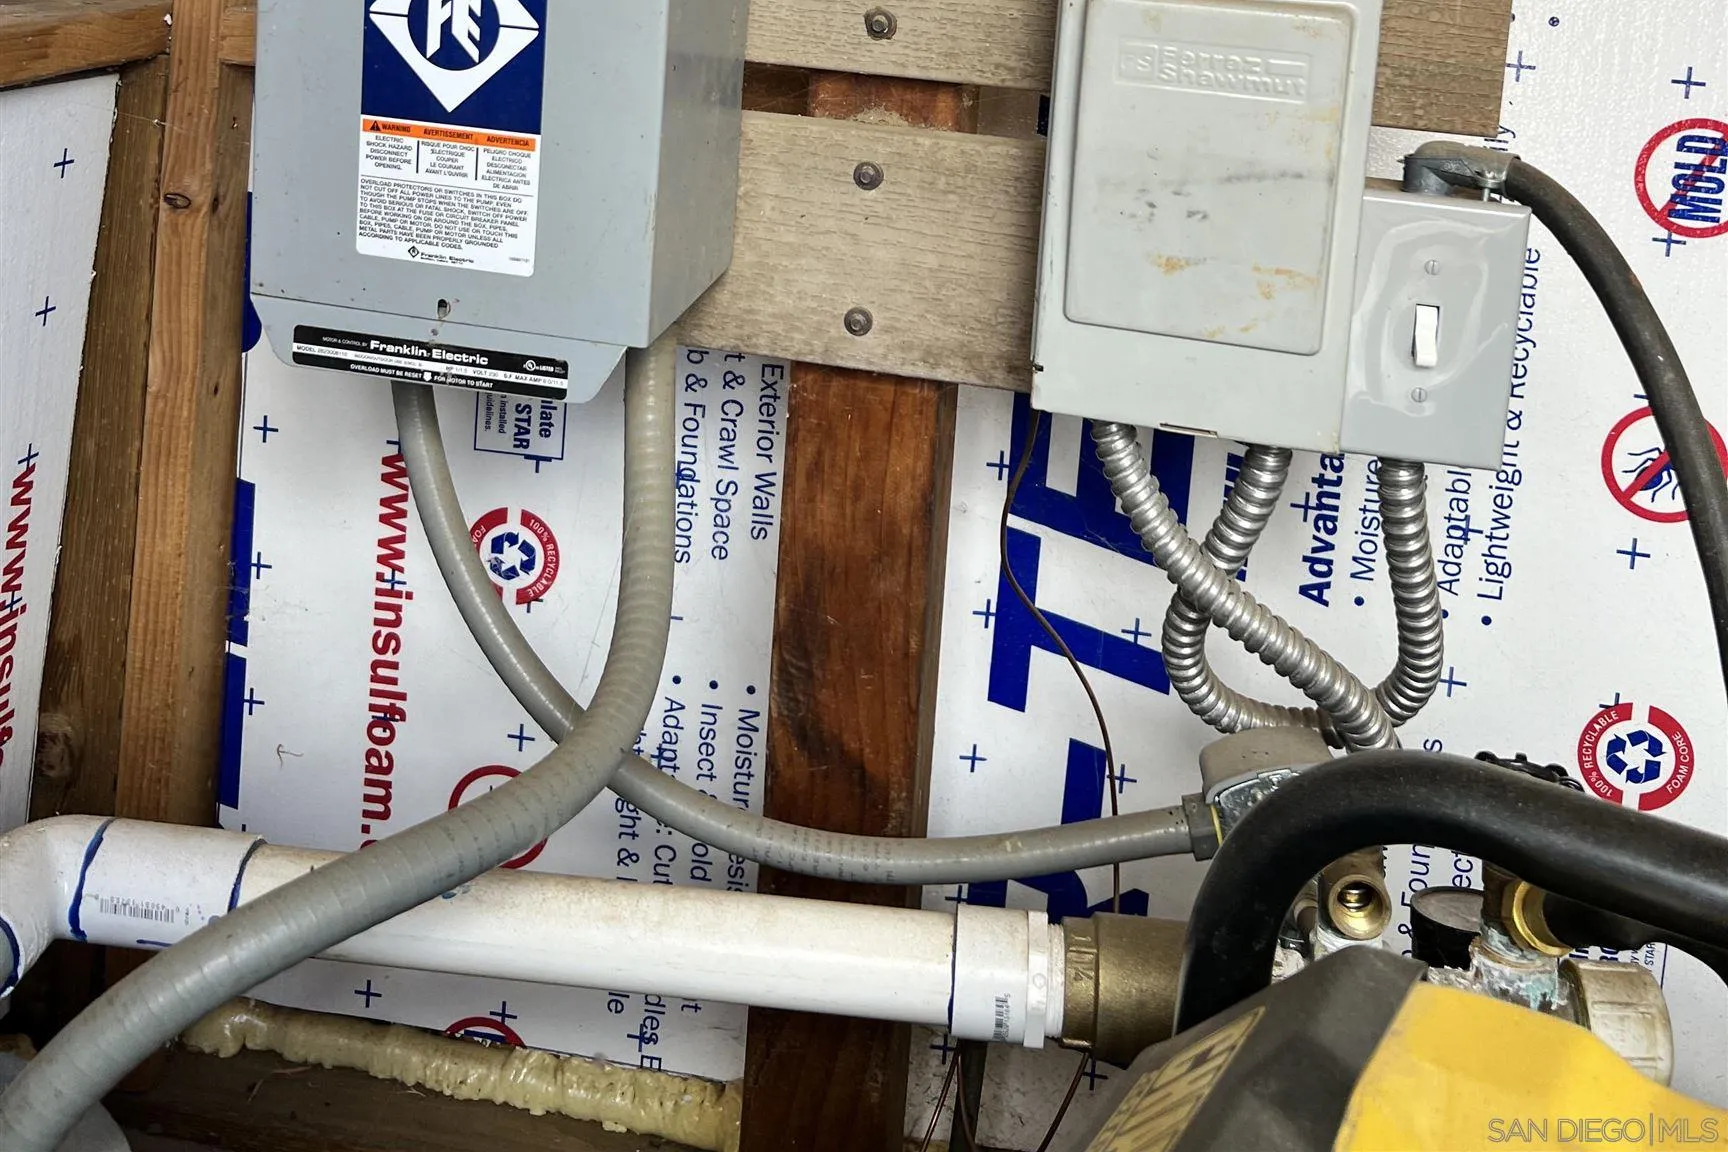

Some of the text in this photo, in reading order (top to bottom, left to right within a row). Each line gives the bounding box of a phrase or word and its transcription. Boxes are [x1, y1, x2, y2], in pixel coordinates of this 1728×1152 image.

[375, 135, 404, 144] ELECTRIC
[381, 123, 411, 133] WARNING
[370, 148, 408, 157] DISCONNECT
[388, 144, 413, 152] HAZARD
[487, 135, 530, 147] ADVERTENCIA
[388, 157, 412, 165] BEFORE
[360, 178, 392, 187] OVERLOAD
[1667, 134, 1728, 224] MOLD
[296, 345, 316, 353] MODEL
[370, 339, 427, 357] Franklin
[431, 348, 489, 366] Electric
[350, 364, 380, 373] OVERLOAD
[380, 367, 395, 375] MUST
[404, 371, 423, 379] RESET
[447, 377, 466, 385] MOTOR
[475, 380, 494, 388] START
[513, 403, 532, 449] STAR
[750, 363, 784, 541] Exterior Walls
[675, 373, 708, 564] & Foundations
[711, 370, 746, 560] & Crawl Space
[527, 519, 556, 597] 100% RECYCLABLE
[697, 703, 723, 782] Insect
[1582, 710, 1618, 796] 100% RECYCLABLE
[1666, 731, 1689, 794] FOAM CORE
[617, 847, 640, 867] &
